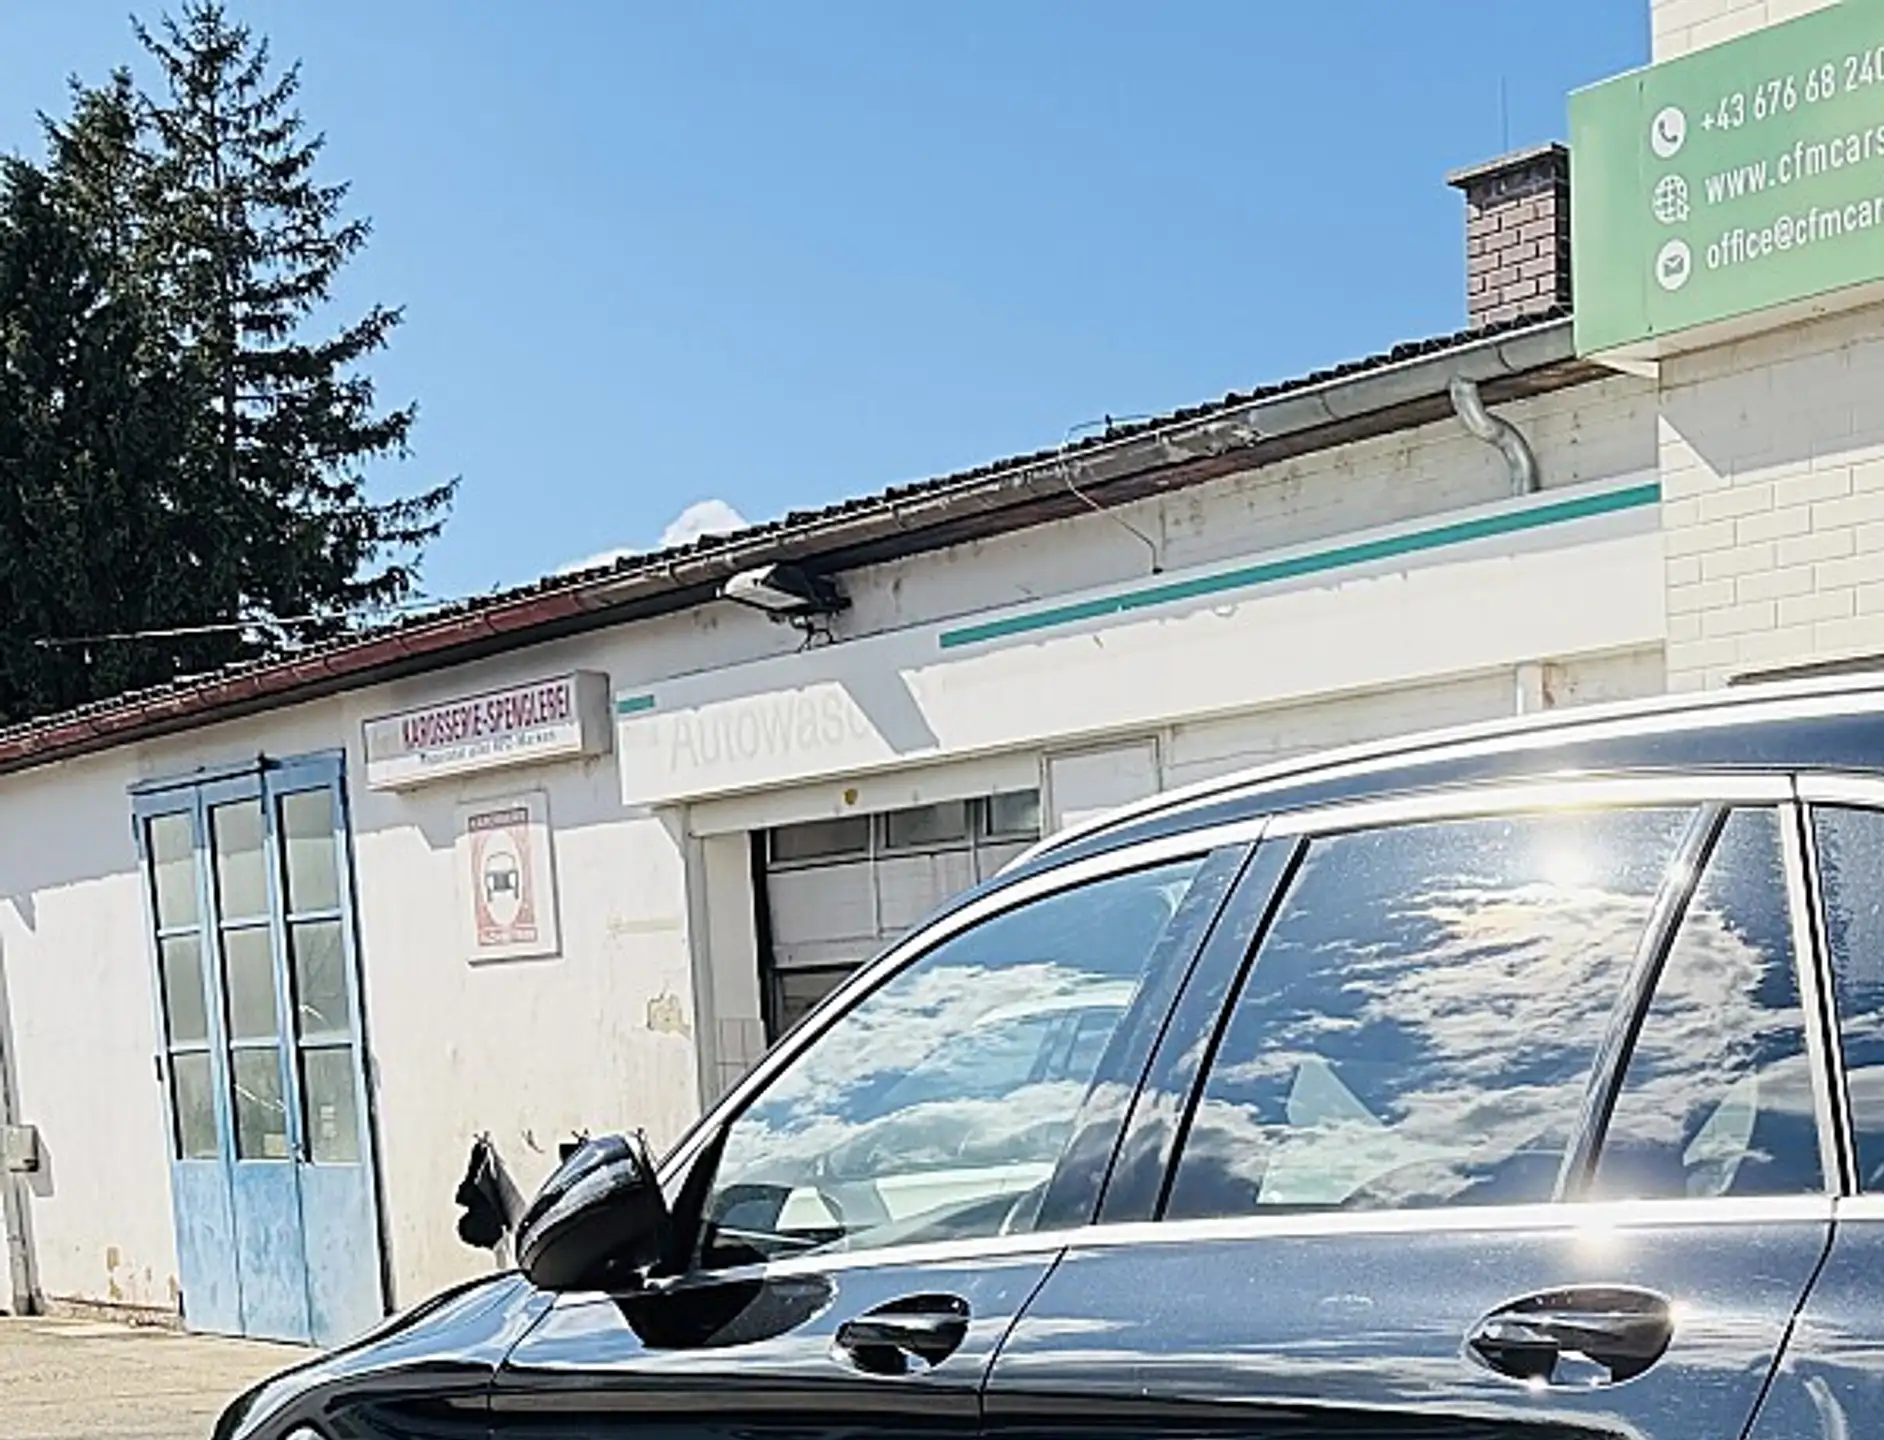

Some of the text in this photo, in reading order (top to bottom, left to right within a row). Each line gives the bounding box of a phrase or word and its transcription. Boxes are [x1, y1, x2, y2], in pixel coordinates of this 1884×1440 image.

[1700, 93, 1745, 131] +43
[1753, 74, 1798, 121] 676
[1804, 62, 1836, 103] 68
